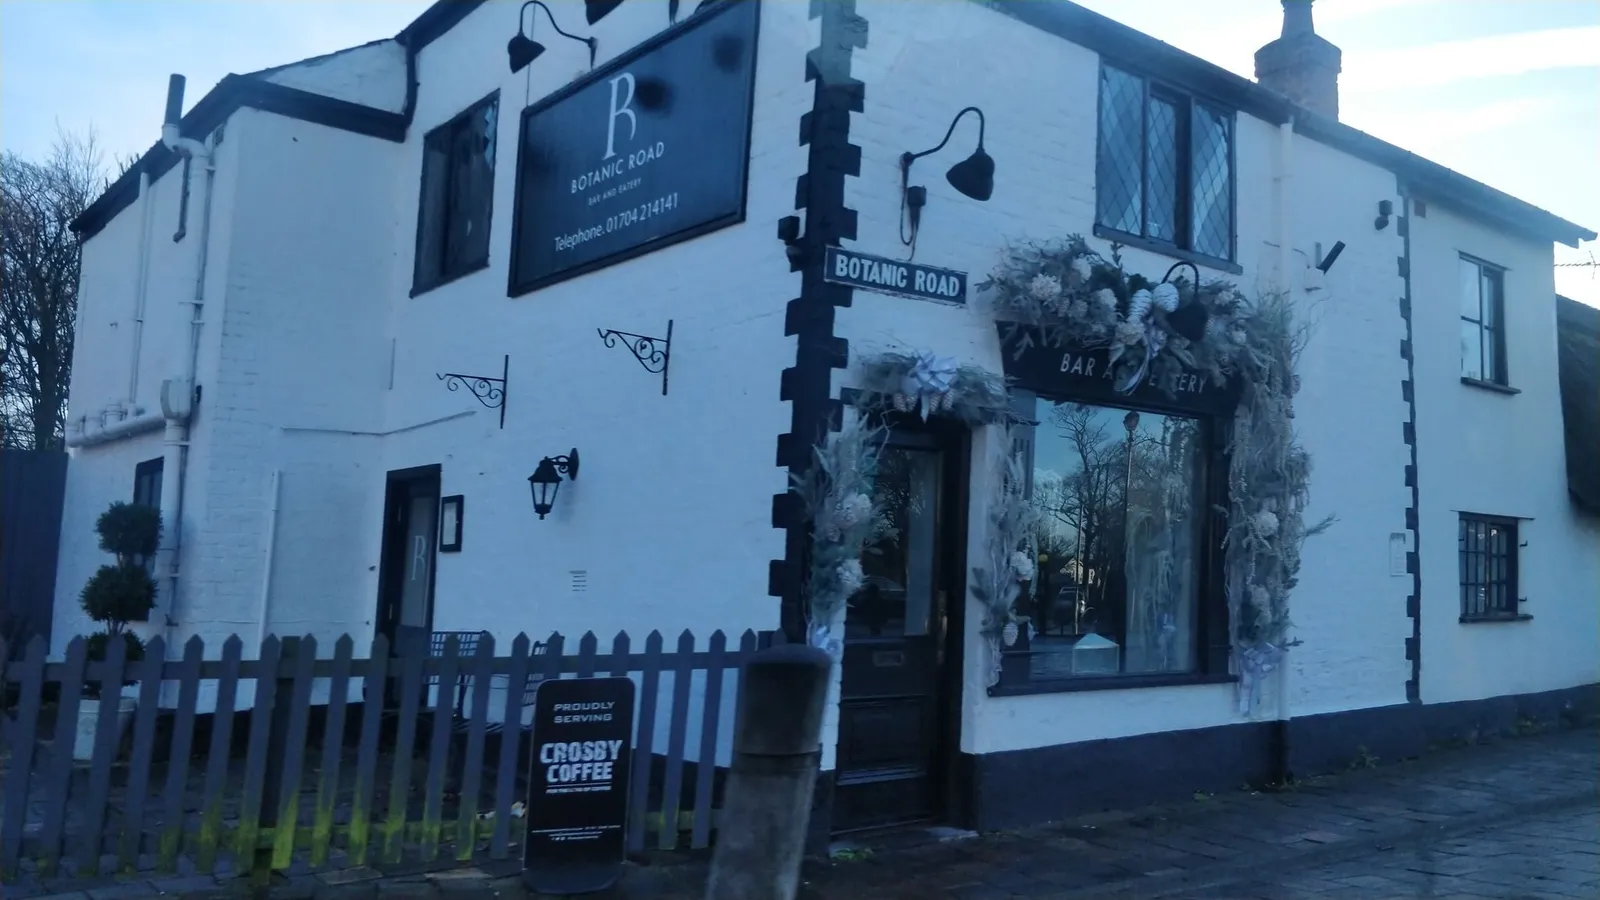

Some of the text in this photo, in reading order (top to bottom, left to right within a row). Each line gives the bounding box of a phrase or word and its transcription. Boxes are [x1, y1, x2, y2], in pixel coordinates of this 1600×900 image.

[602, 72, 637, 160] R
[571, 141, 665, 193] BOTANIC ROAD
[603, 187, 617, 200] AND
[618, 177, 642, 194] EATERY
[555, 192, 679, 252] Telephone. 01704 214141
[835, 254, 960, 297] BOTANIC ROAD
[1060, 353, 1096, 377] BAR
[553, 701, 615, 713] PROUDLY
[553, 713, 613, 724] SERVING
[540, 739, 623, 764] CROSBY
[547, 762, 614, 783] COFFEE
